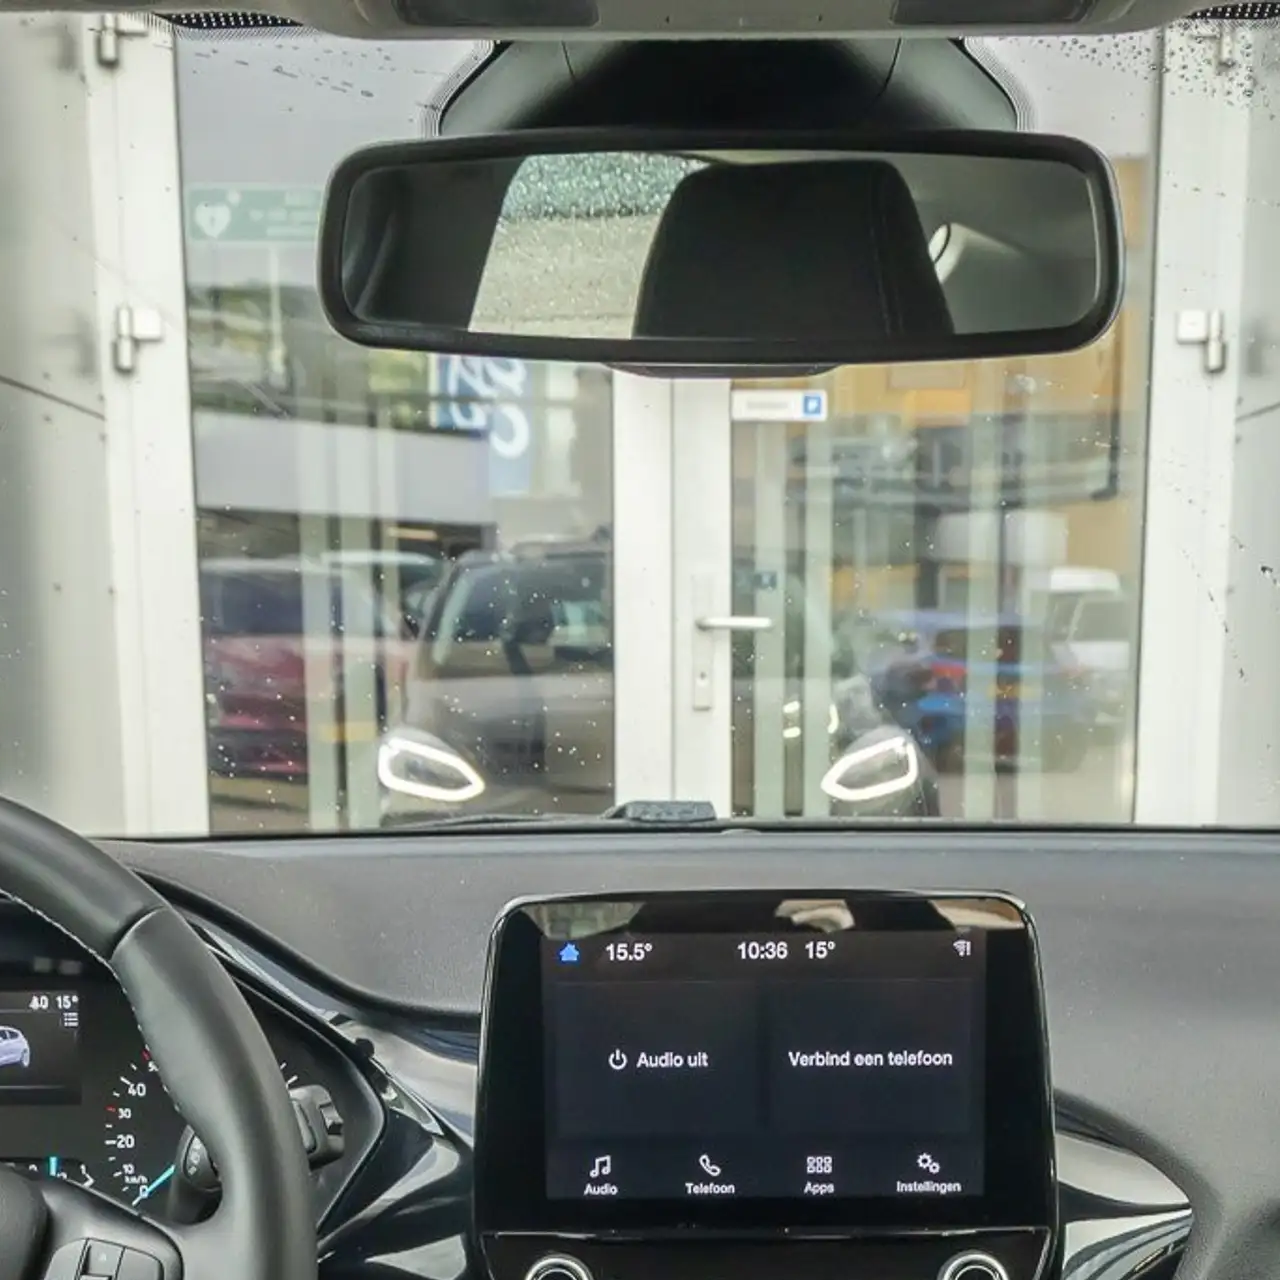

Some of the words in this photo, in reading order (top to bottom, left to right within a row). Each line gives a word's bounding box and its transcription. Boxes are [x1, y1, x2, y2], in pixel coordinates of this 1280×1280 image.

[737, 940, 788, 960] 10:36
[636, 1051, 684, 1068] Audio
[687, 1051, 709, 1067] uit
[788, 1050, 851, 1067] Verbind
[854, 1053, 884, 1067] een
[887, 1050, 953, 1066] telefoon
[127, 1082, 147, 1097] 40
[118, 1107, 132, 1119] 30
[116, 1134, 135, 1149] 20
[122, 1163, 135, 1174] 10
[124, 1175, 148, 1184] km/h
[584, 1182, 618, 1196] Audio
[685, 1181, 736, 1195] Telefoon
[803, 1181, 835, 1196] Apps
[896, 1180, 962, 1195] Instellingen
